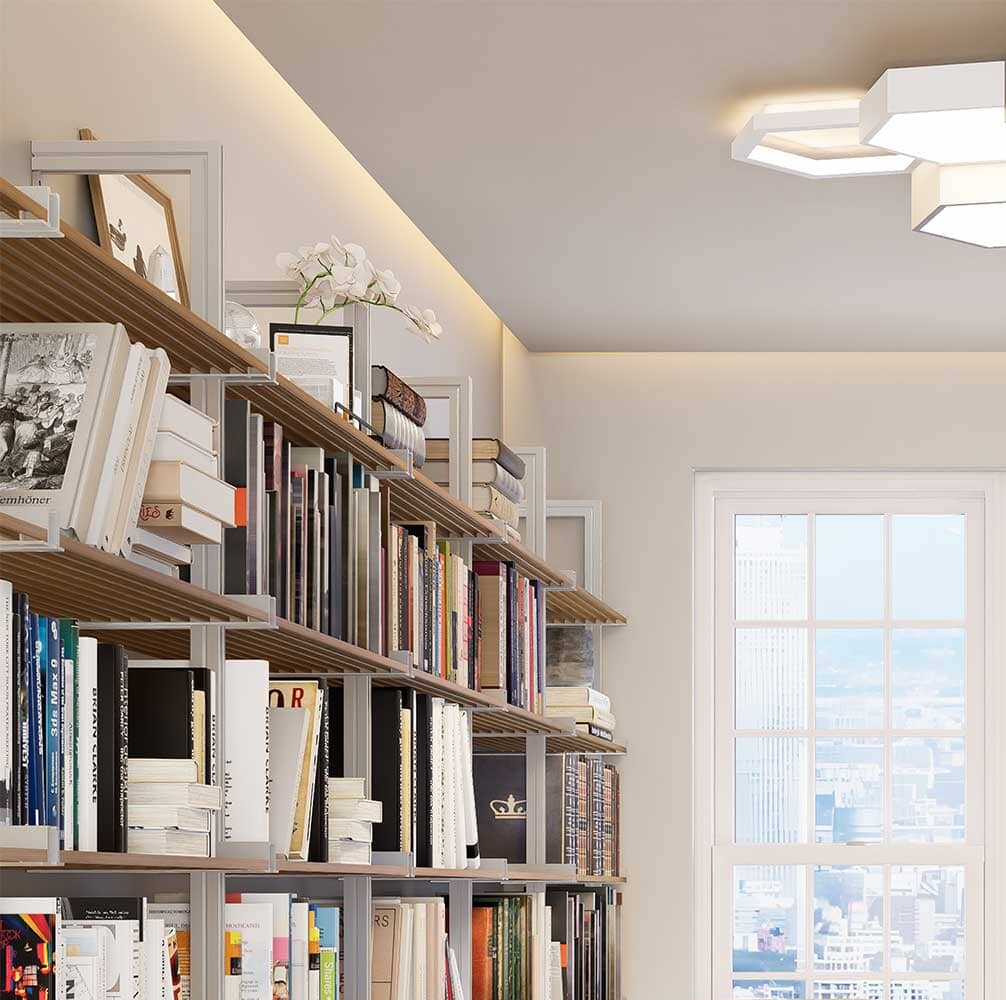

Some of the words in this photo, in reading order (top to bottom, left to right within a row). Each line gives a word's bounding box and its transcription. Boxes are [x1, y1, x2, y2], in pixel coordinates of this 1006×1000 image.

[0, 494, 52, 505] emhöner
[50, 658, 58, 668] 9
[50, 673, 58, 705] Max
[50, 709, 58, 737] 3ds
[323, 961, 333, 996] Shares
